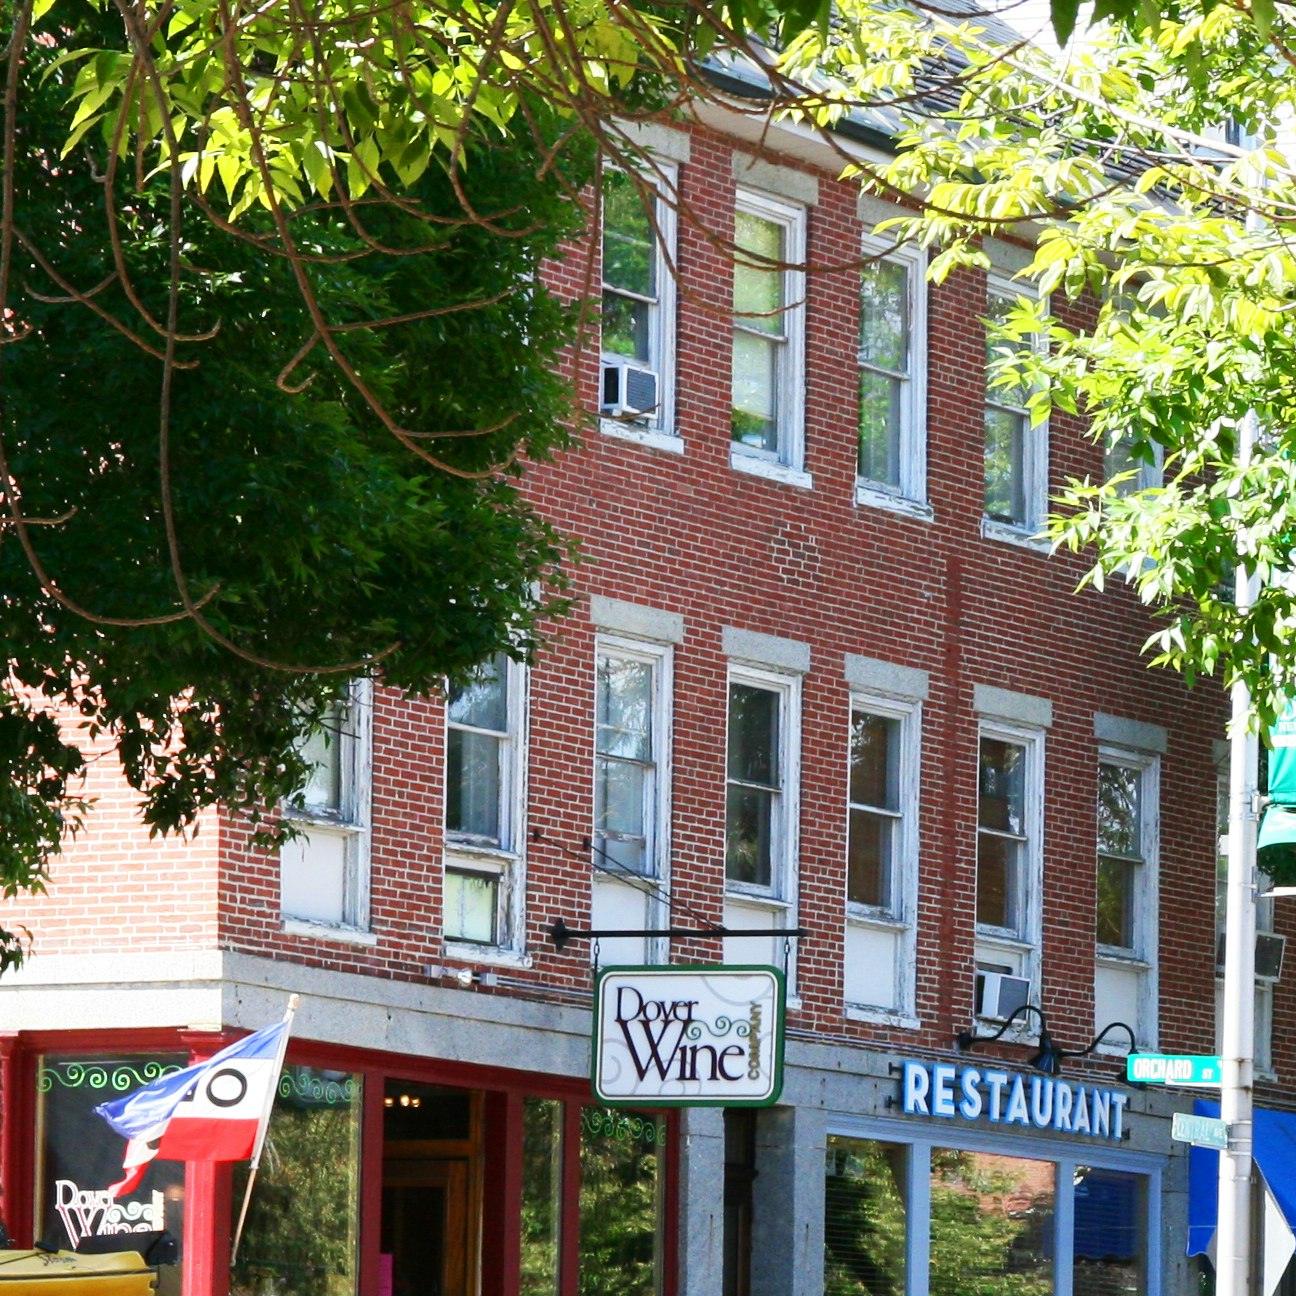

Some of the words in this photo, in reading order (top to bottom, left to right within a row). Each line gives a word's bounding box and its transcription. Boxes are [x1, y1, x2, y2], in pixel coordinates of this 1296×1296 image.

[616, 986, 699, 1021] Dover
[615, 1020, 746, 1082] Wine
[748, 1001, 762, 1081] COMPANY
[1133, 1057, 1192, 1080] ORCHARD
[1201, 1068, 1213, 1080] ST
[903, 1059, 1127, 1141] RESTAURANT
